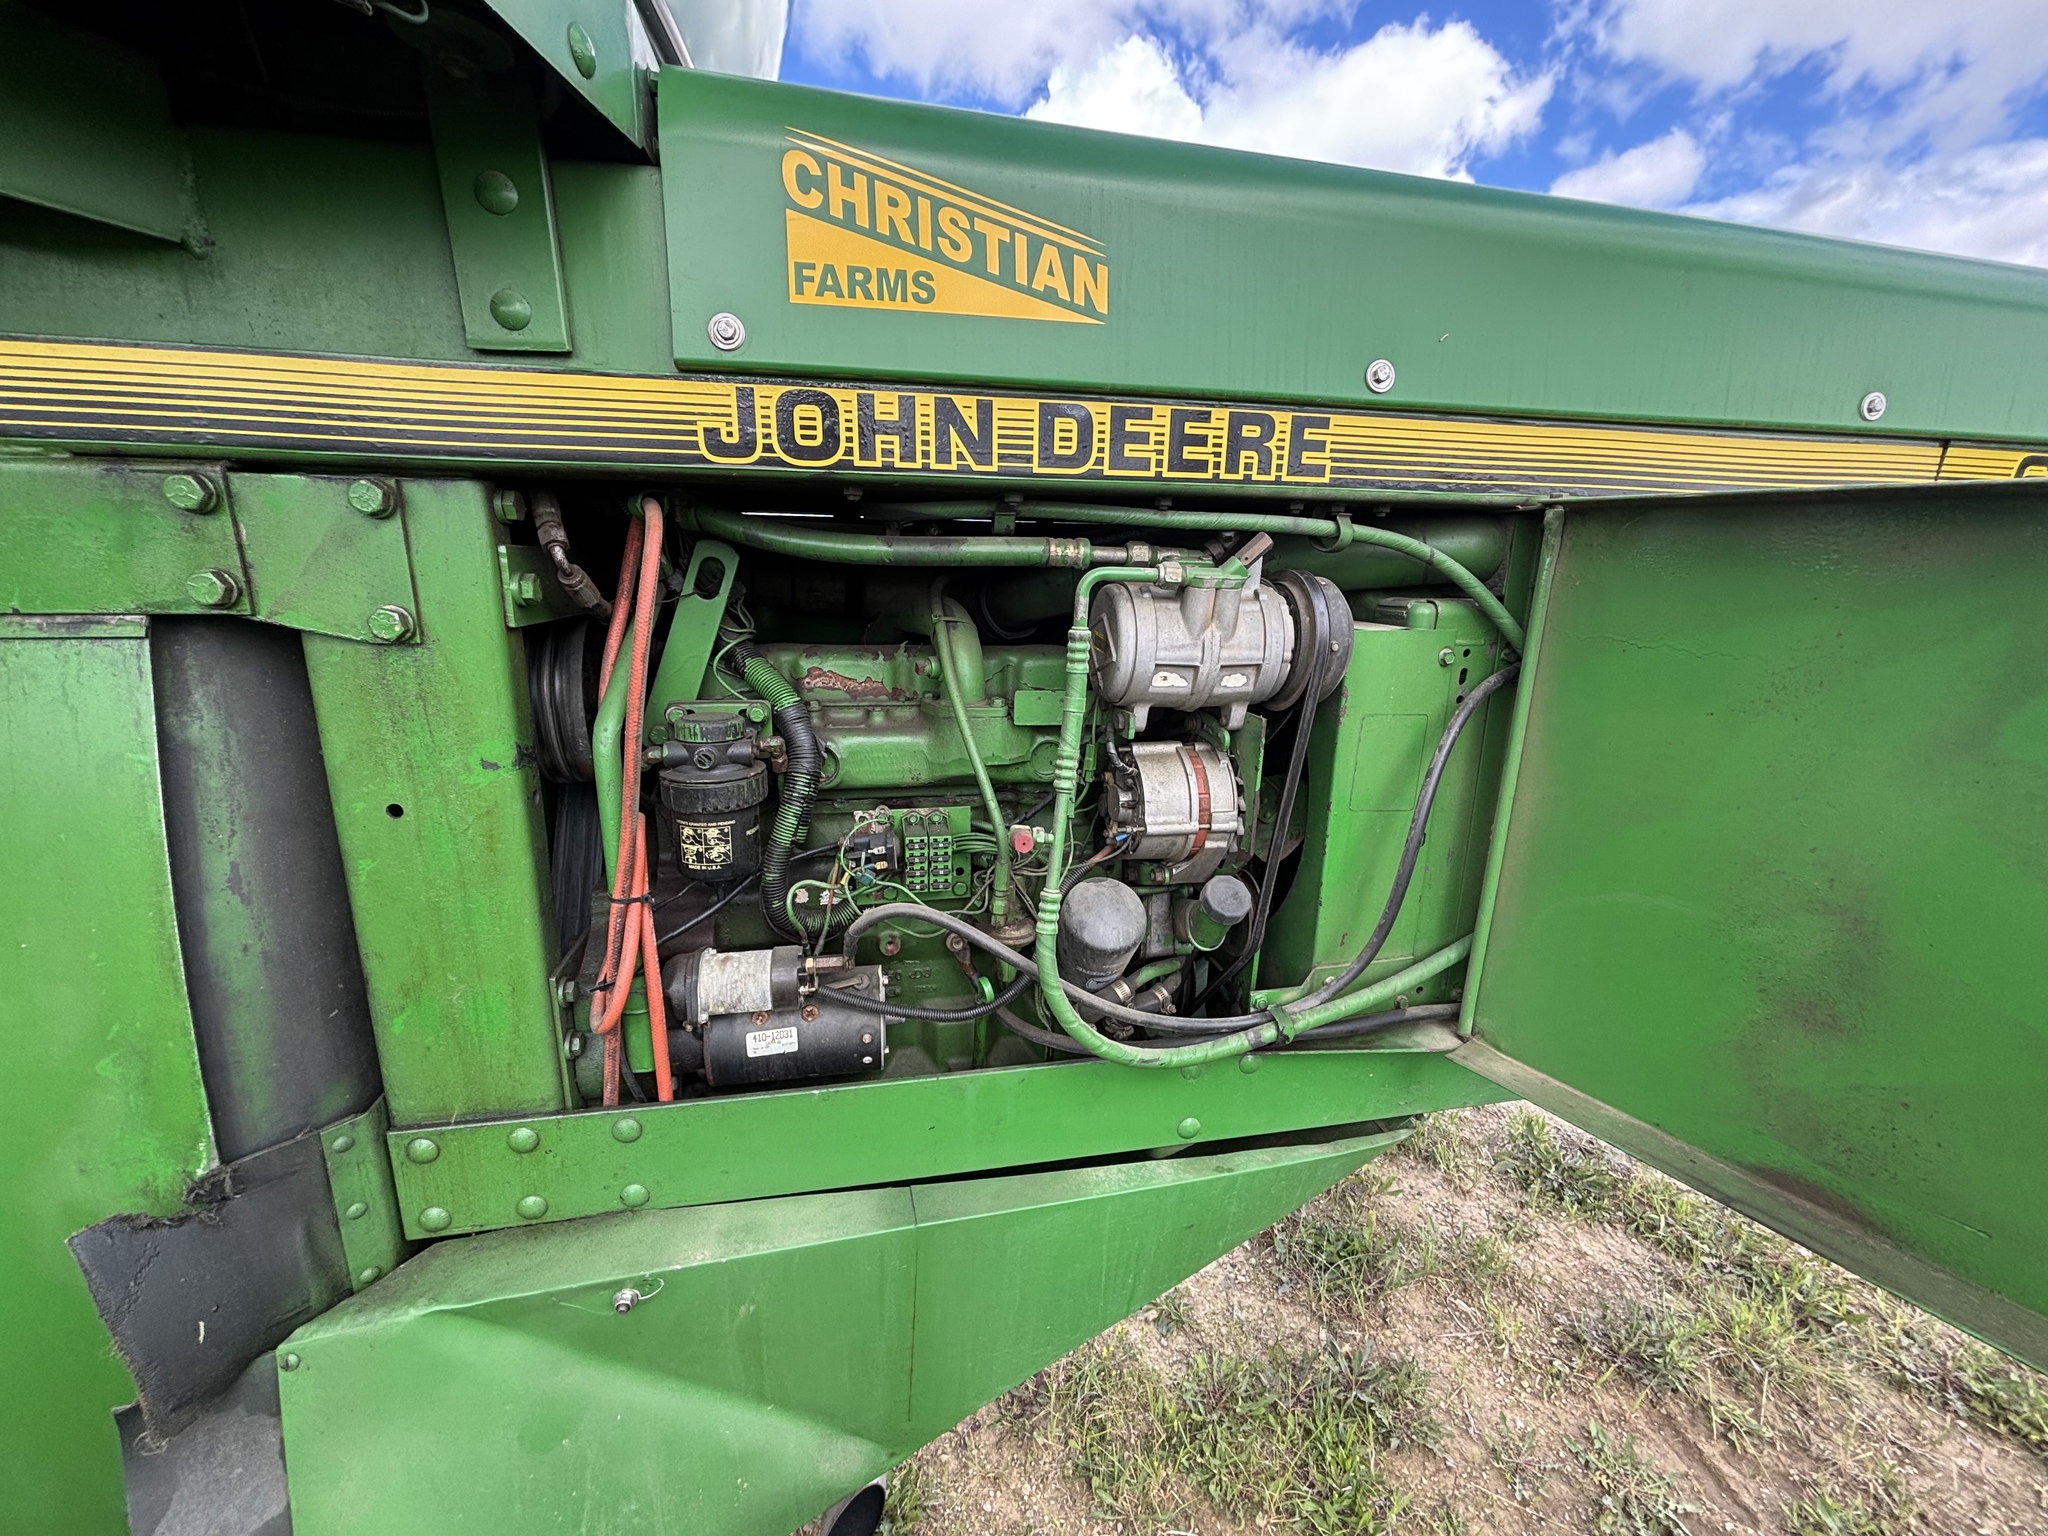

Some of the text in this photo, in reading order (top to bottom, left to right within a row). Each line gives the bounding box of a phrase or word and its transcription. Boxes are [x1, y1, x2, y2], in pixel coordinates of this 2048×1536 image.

[782, 149, 1108, 315] CHRISTIAN
[793, 261, 936, 304] FARMS
[697, 385, 1331, 483] JOHN DEERE
[752, 1029, 793, 1043] 410-12031
